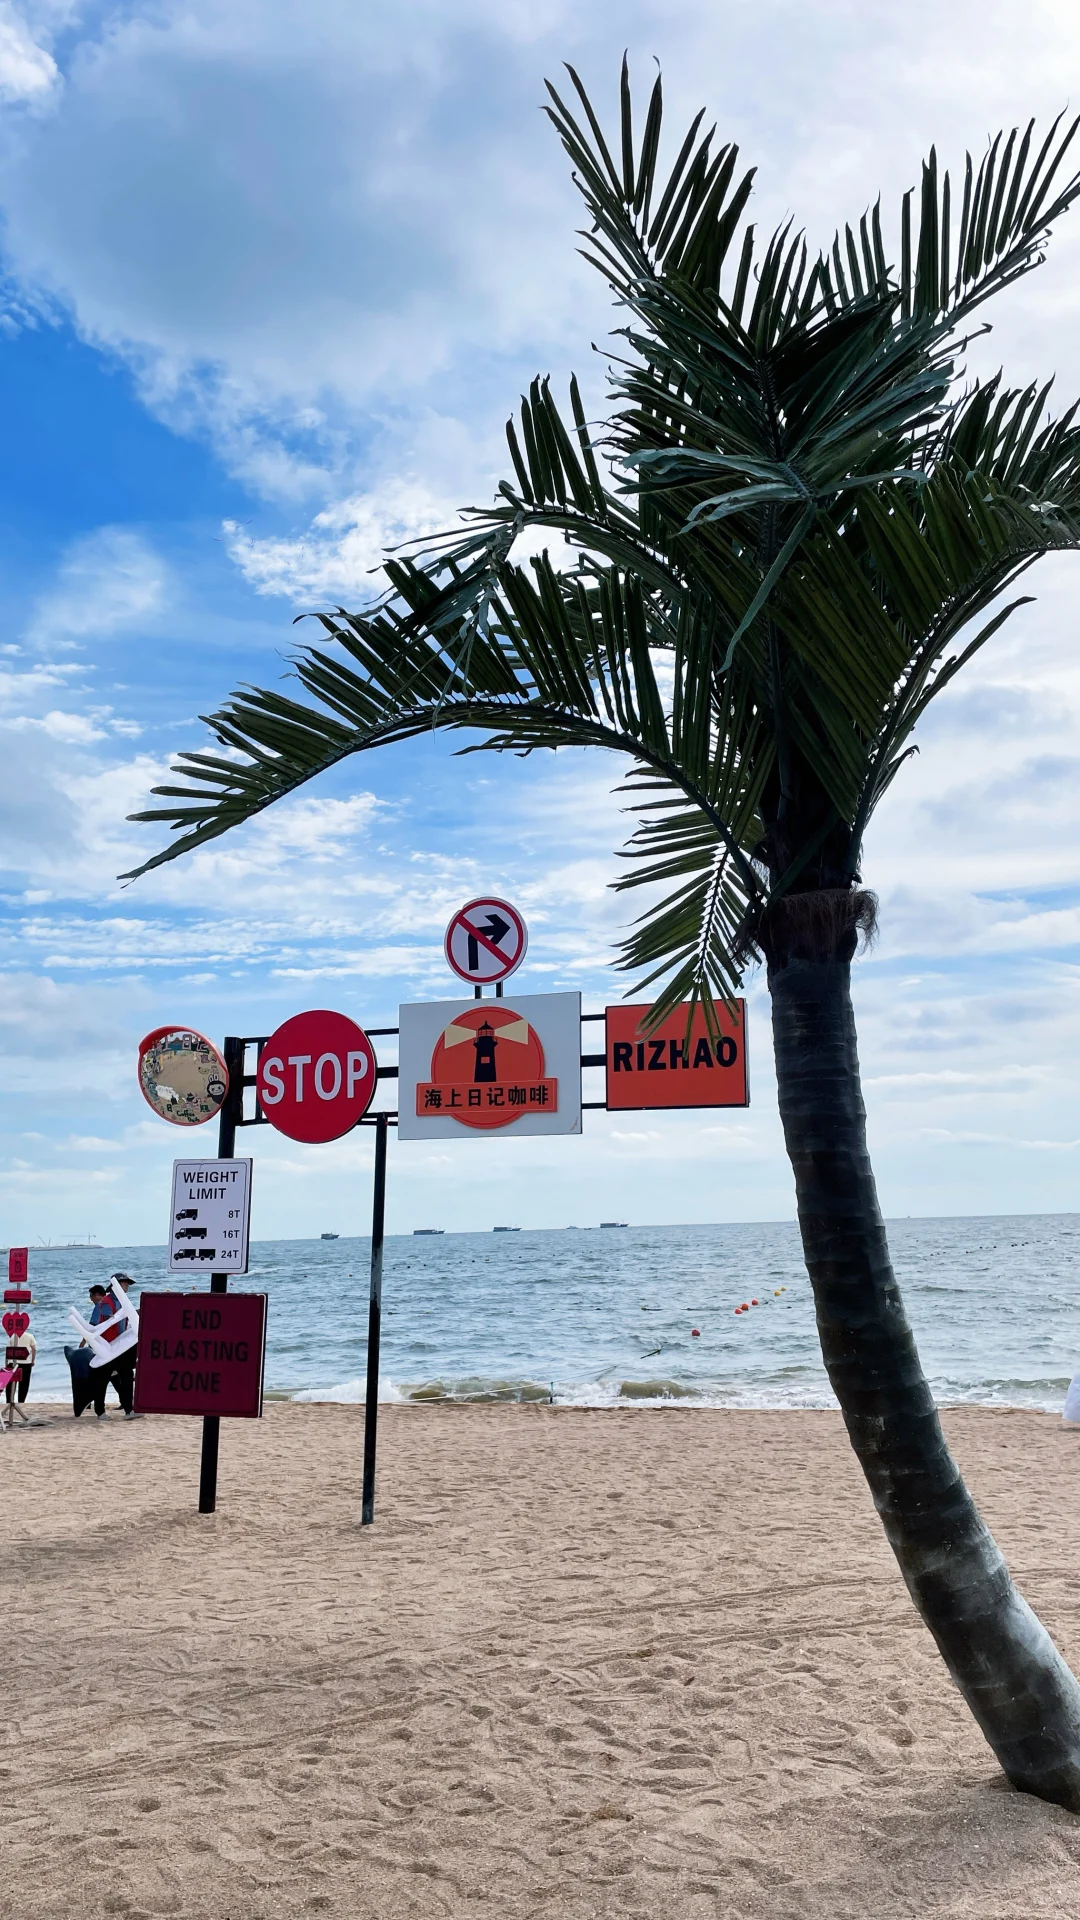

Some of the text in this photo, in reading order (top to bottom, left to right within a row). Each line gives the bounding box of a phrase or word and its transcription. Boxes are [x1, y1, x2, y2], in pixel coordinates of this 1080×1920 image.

[613, 1036, 738, 1072] RIZHAO
[262, 1050, 369, 1105] STOP
[424, 1085, 549, 1109] 海上日记咖啡
[183, 1171, 239, 1183] WEIGHT
[188, 1188, 227, 1200] LIMIT
[228, 1209, 241, 1219] 8T
[222, 1229, 240, 1239] 16T
[220, 1249, 239, 1259] 24T
[181, 1309, 222, 1330] END
[150, 1339, 248, 1362] BLASTING
[168, 1370, 221, 1393] ZONE
